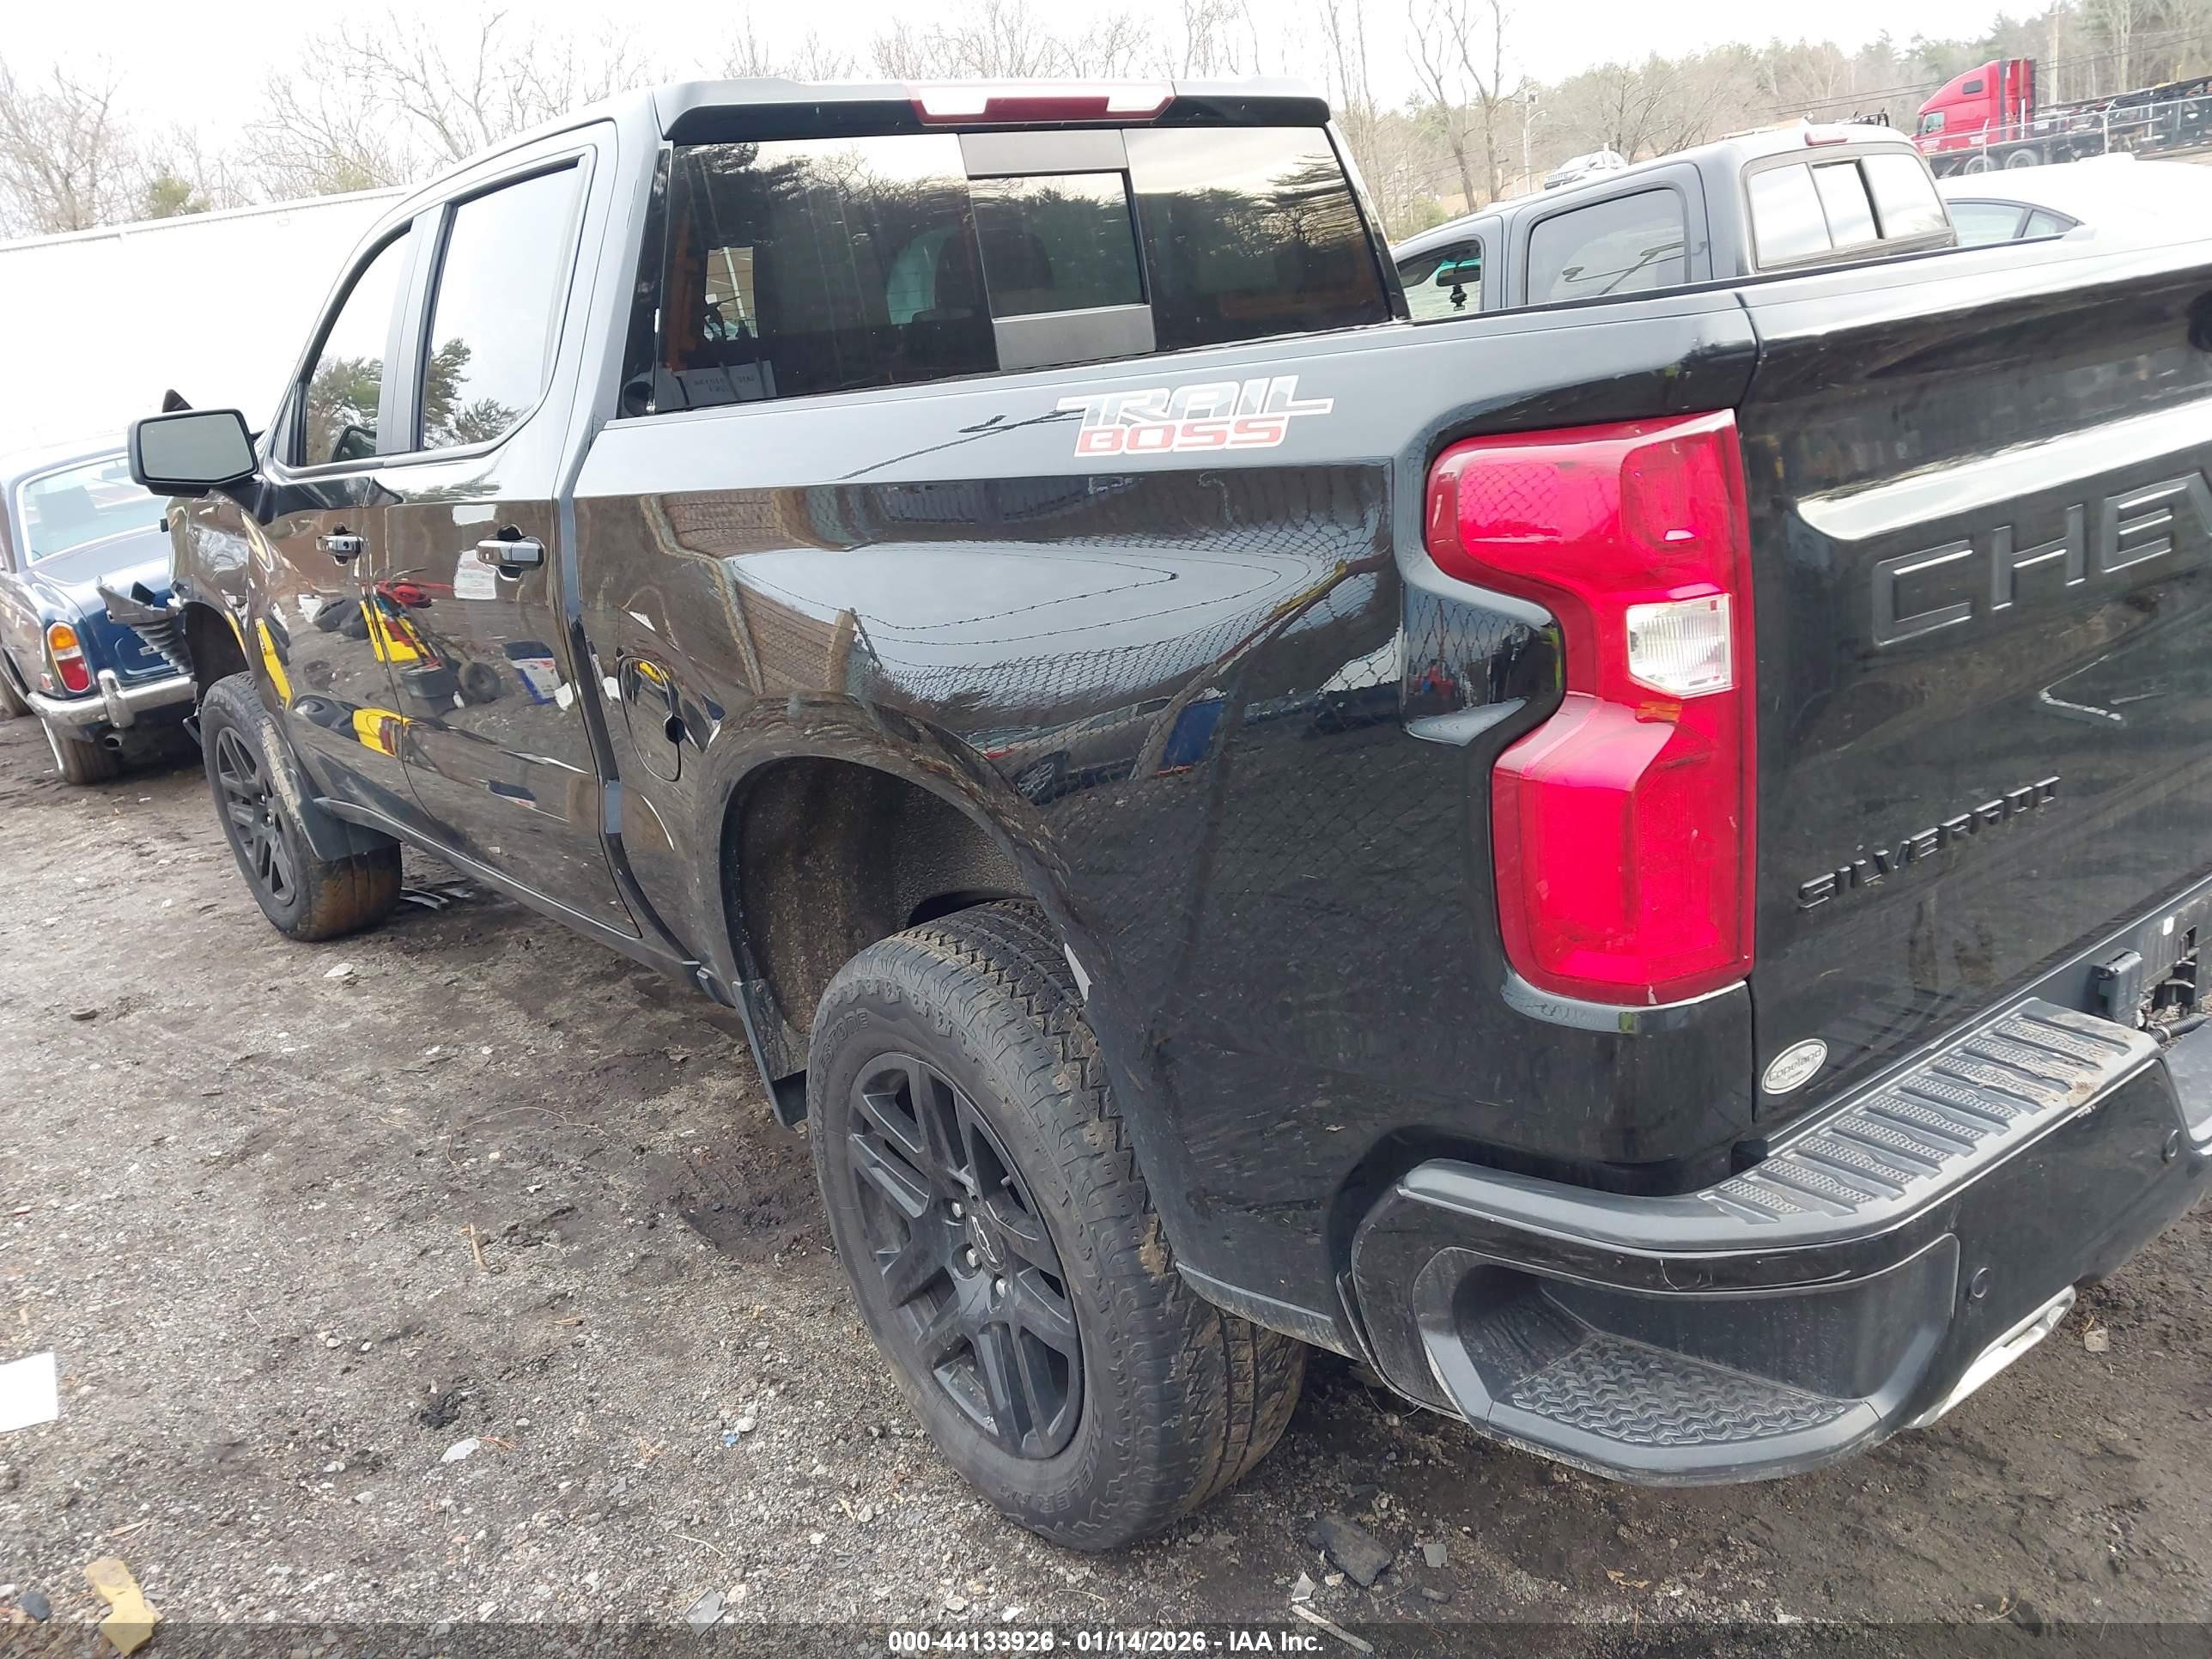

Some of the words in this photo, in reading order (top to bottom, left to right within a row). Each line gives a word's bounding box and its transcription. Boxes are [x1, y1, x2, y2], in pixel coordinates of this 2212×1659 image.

[1054, 374, 1334, 428] TRAIL
[1073, 414, 1291, 458] BOSS
[1798, 775, 2061, 908] SILVERADO
[1769, 1047, 1822, 1082] Copeland
